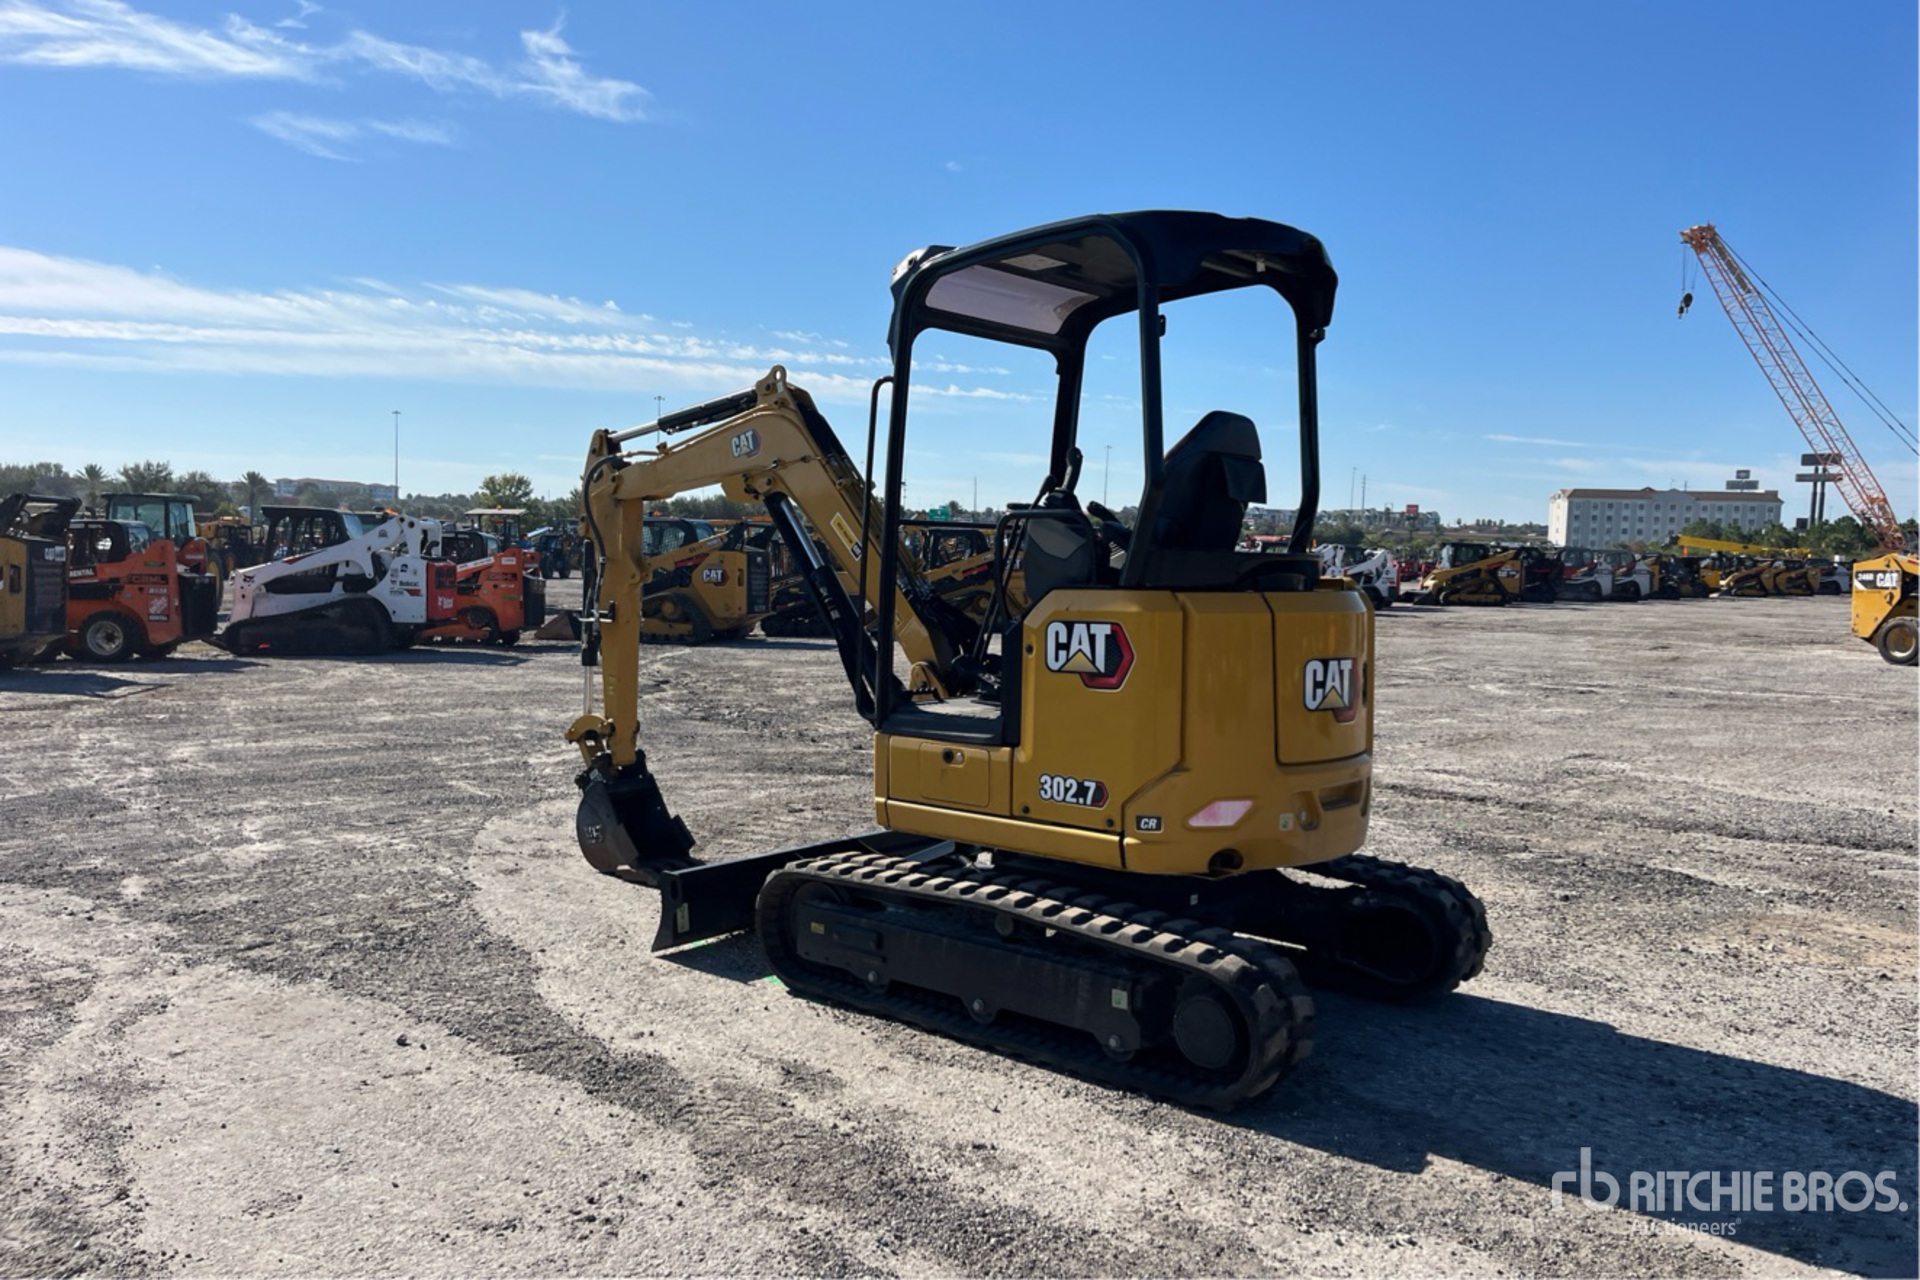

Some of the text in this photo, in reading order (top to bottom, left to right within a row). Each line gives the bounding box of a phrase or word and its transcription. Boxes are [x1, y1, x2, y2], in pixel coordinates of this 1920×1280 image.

[732, 430, 753, 457] CAT
[703, 569, 723, 583] CAT
[1876, 572, 1898, 587] CAT
[1046, 621, 1112, 674] CAT
[1305, 659, 1353, 710] CAT
[1040, 774, 1097, 806] 302.7
[1140, 818, 1158, 830] CR
